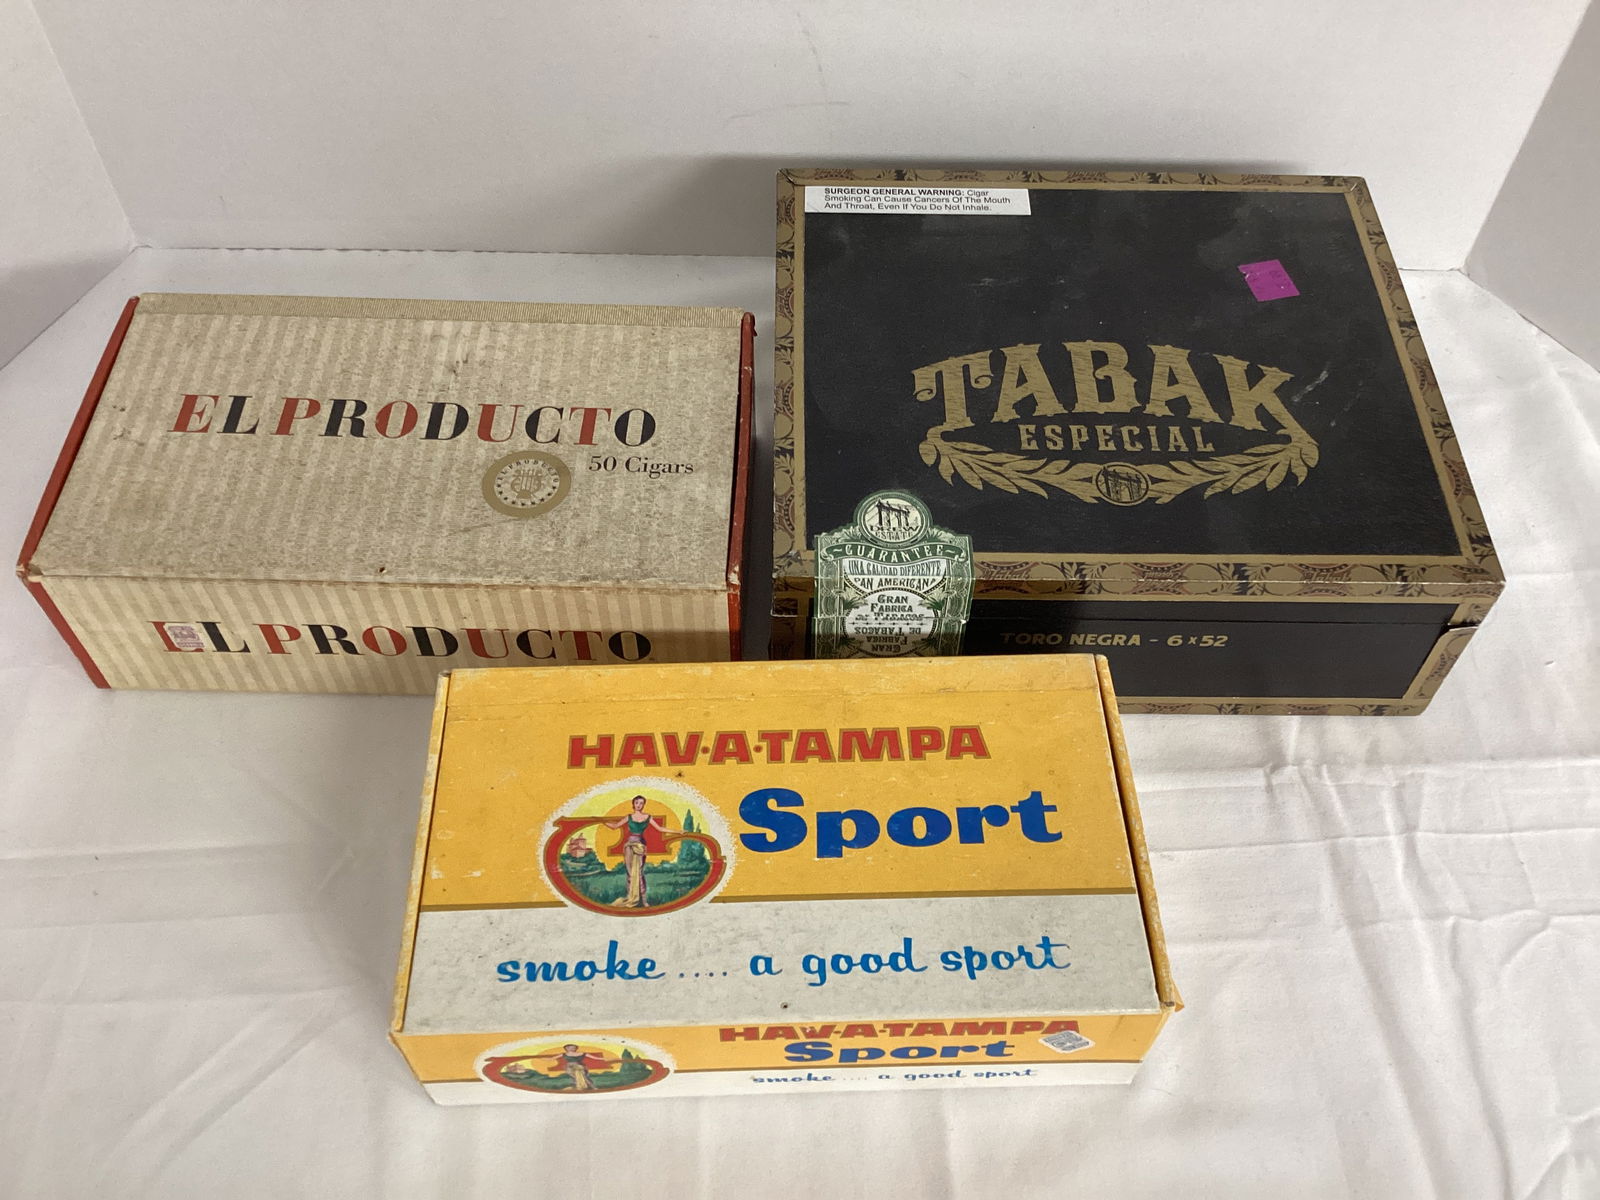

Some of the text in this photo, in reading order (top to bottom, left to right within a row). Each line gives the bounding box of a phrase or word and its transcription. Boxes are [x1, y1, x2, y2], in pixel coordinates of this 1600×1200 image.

[824, 195, 862, 203] Smoking
[844, 202, 875, 210] Throat,
[911, 339, 1319, 446] TABAK
[167, 394, 657, 447] EL PRODUCTO
[1018, 424, 1216, 453] ESPECIAL
[588, 455, 695, 480] 50 Cigars
[845, 544, 944, 563] GUARANTEE
[848, 560, 941, 576] UNA CALIDAD DIFERENTE
[854, 577, 874, 590] PAN
[877, 594, 908, 604] GRAN
[870, 603, 913, 612] FABRICA
[854, 627, 905, 636] TABACOS
[1000, 632, 1063, 645] TORO
[1069, 633, 1141, 646] NEGRA
[252, 623, 653, 661] PRODUCTO
[871, 644, 901, 653] GRAN
[738, 788, 1063, 859] Sport
[750, 954, 783, 977] a
[802, 937, 928, 987] good
[940, 936, 1071, 980] sport
[784, 1040, 1015, 1064] Sport
[878, 1073, 895, 1081] a
[904, 1069, 968, 1082] good
[973, 1068, 1039, 1081] sport
